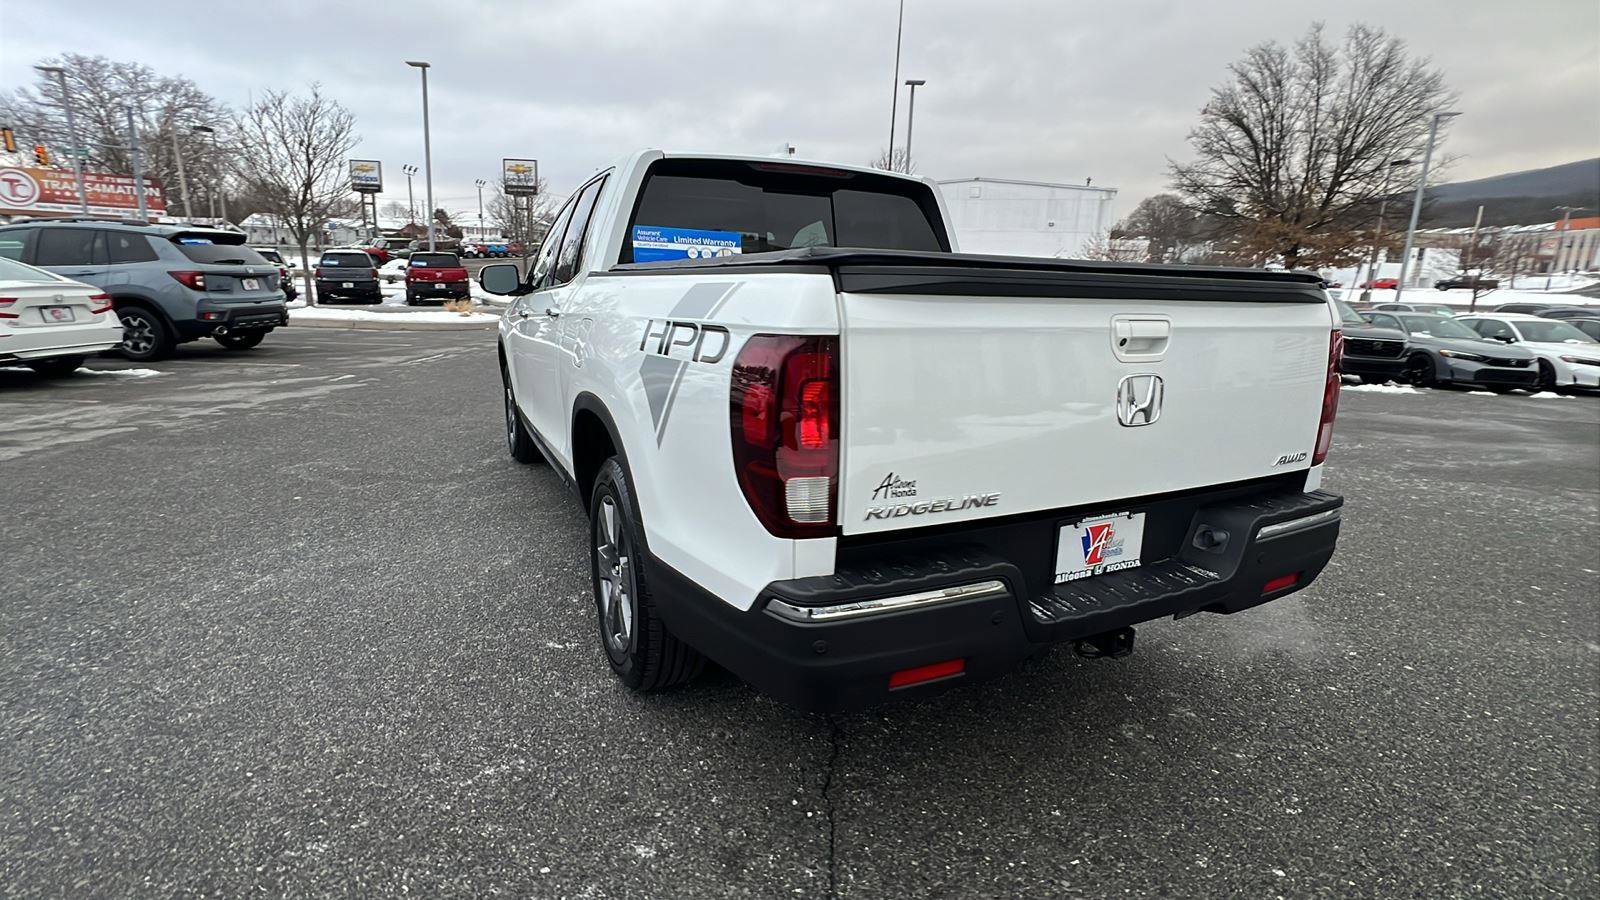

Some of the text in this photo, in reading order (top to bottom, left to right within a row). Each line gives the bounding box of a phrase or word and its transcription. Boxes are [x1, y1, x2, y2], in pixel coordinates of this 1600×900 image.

[673, 236, 737, 248] Limited Warranty
[640, 319, 730, 364] HPD
[1271, 452, 1307, 467] AWD
[864, 492, 1001, 520] RIDGELINE
[1055, 569, 1092, 584] Altoona
[1106, 559, 1141, 573] HONDA
